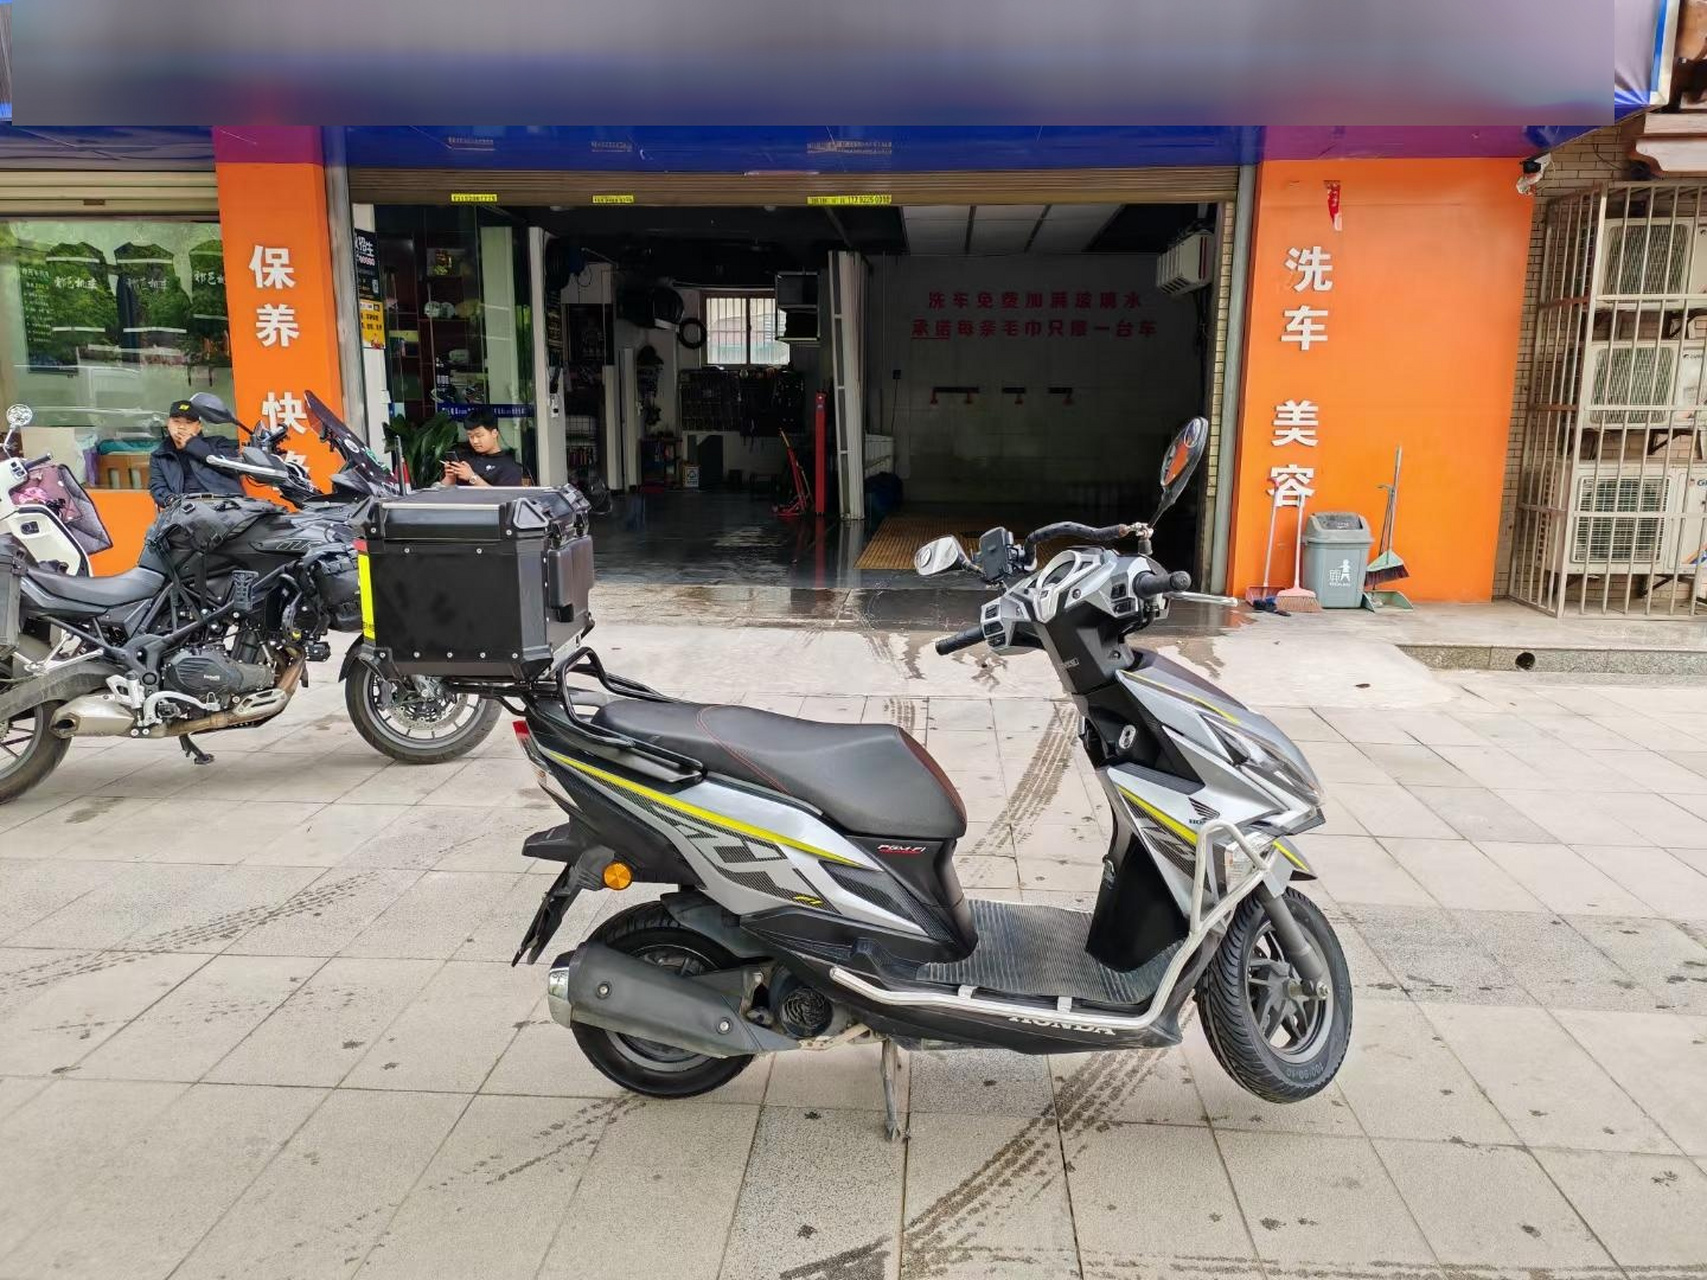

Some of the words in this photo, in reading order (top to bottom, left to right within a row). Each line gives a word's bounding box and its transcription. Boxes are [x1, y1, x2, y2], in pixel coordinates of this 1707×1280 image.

[248, 244, 300, 348] 保养
[1281, 246, 1334, 351] 洗车
[1266, 400, 1319, 508] 美容
